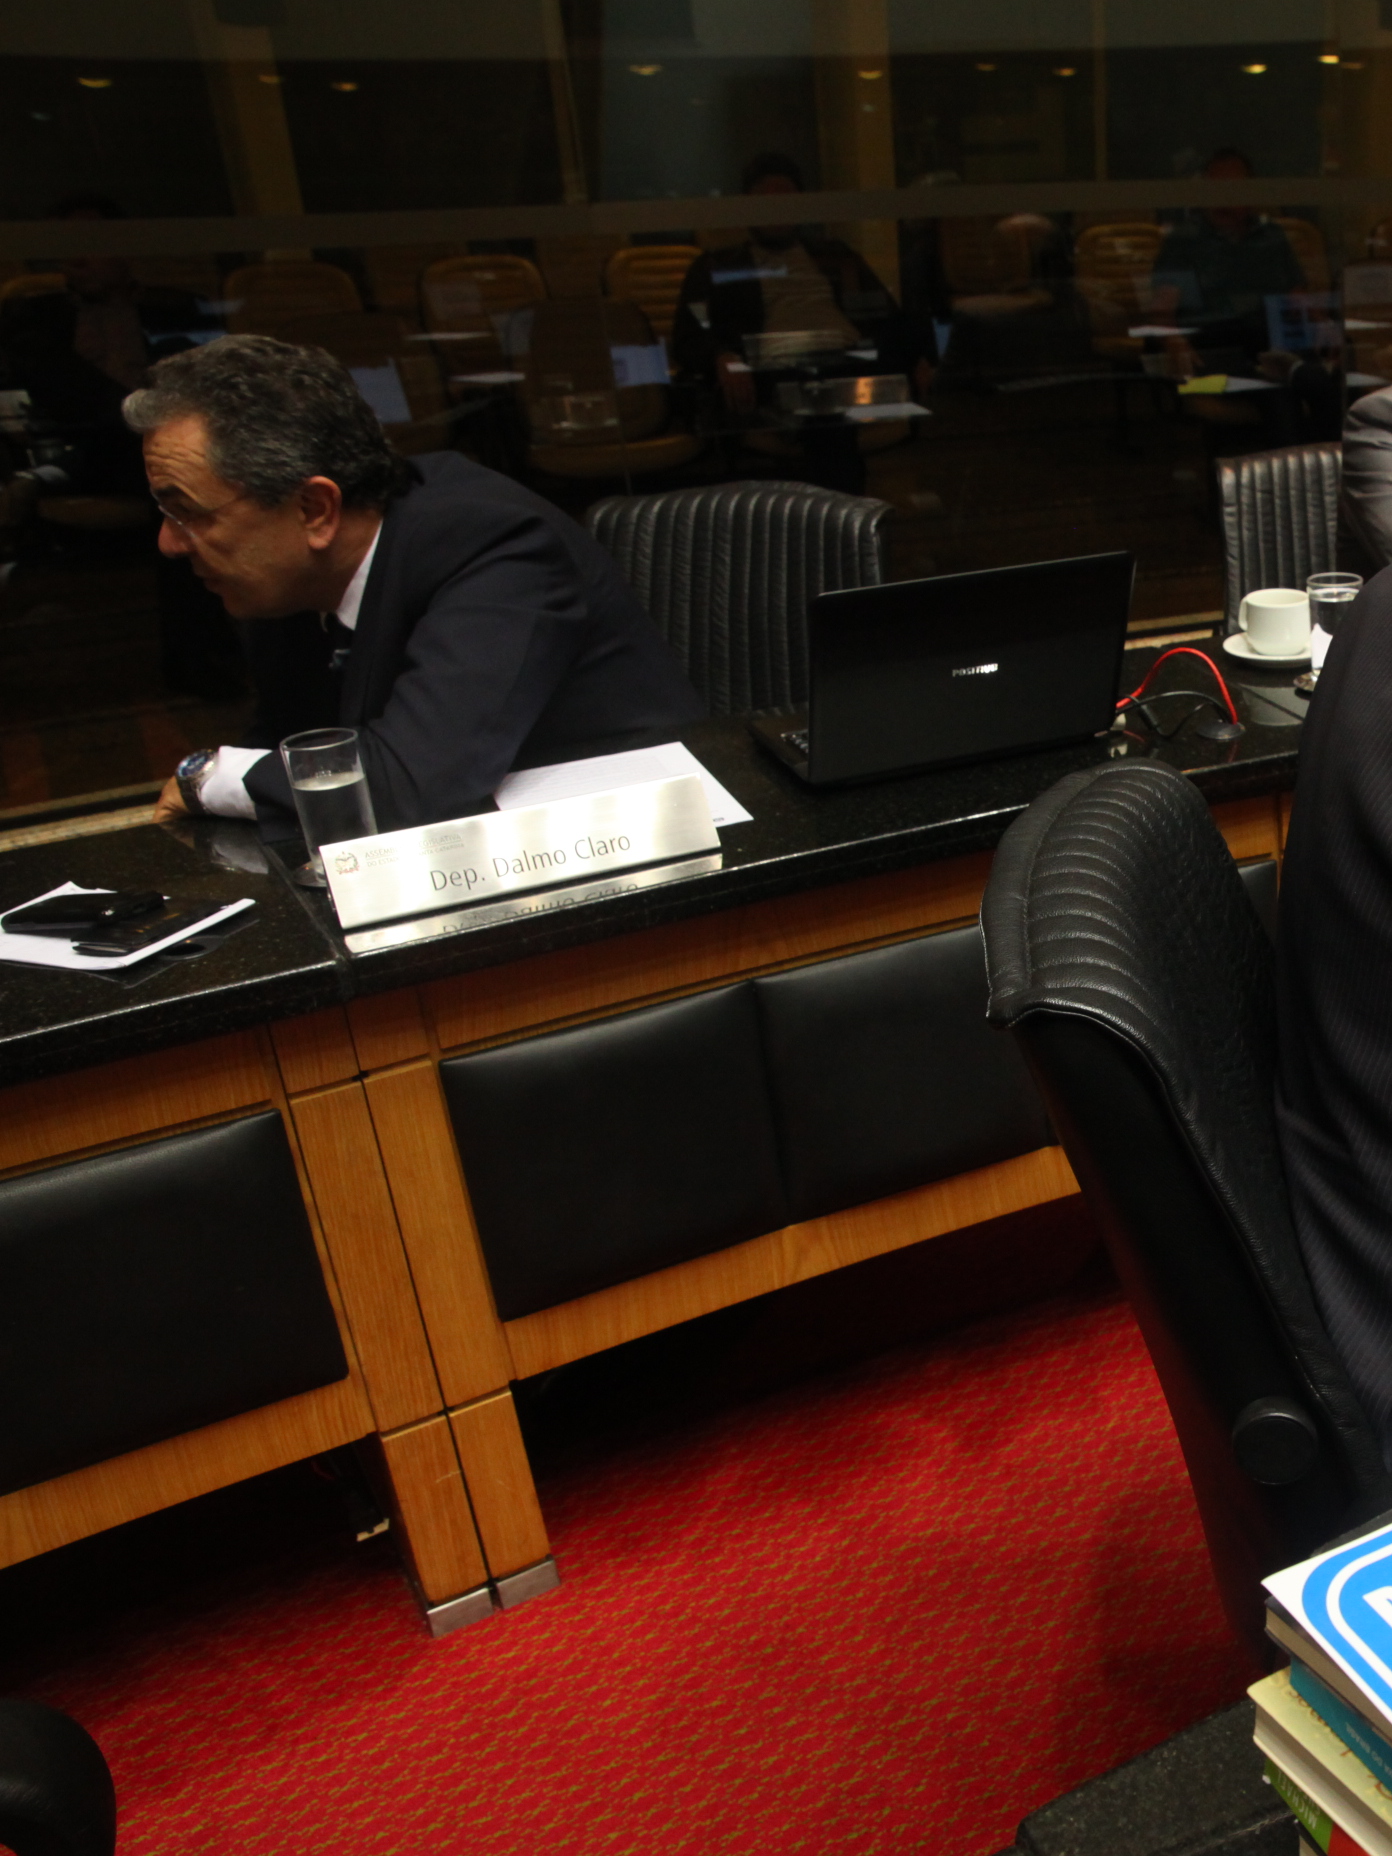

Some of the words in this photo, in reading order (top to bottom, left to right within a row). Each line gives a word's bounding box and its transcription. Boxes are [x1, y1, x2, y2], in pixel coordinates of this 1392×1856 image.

[429, 864, 486, 892] Dep.
[492, 846, 567, 879] Dalmo
[574, 832, 631, 861] Claro
[1278, 1770, 1318, 1830] MICHAEL
